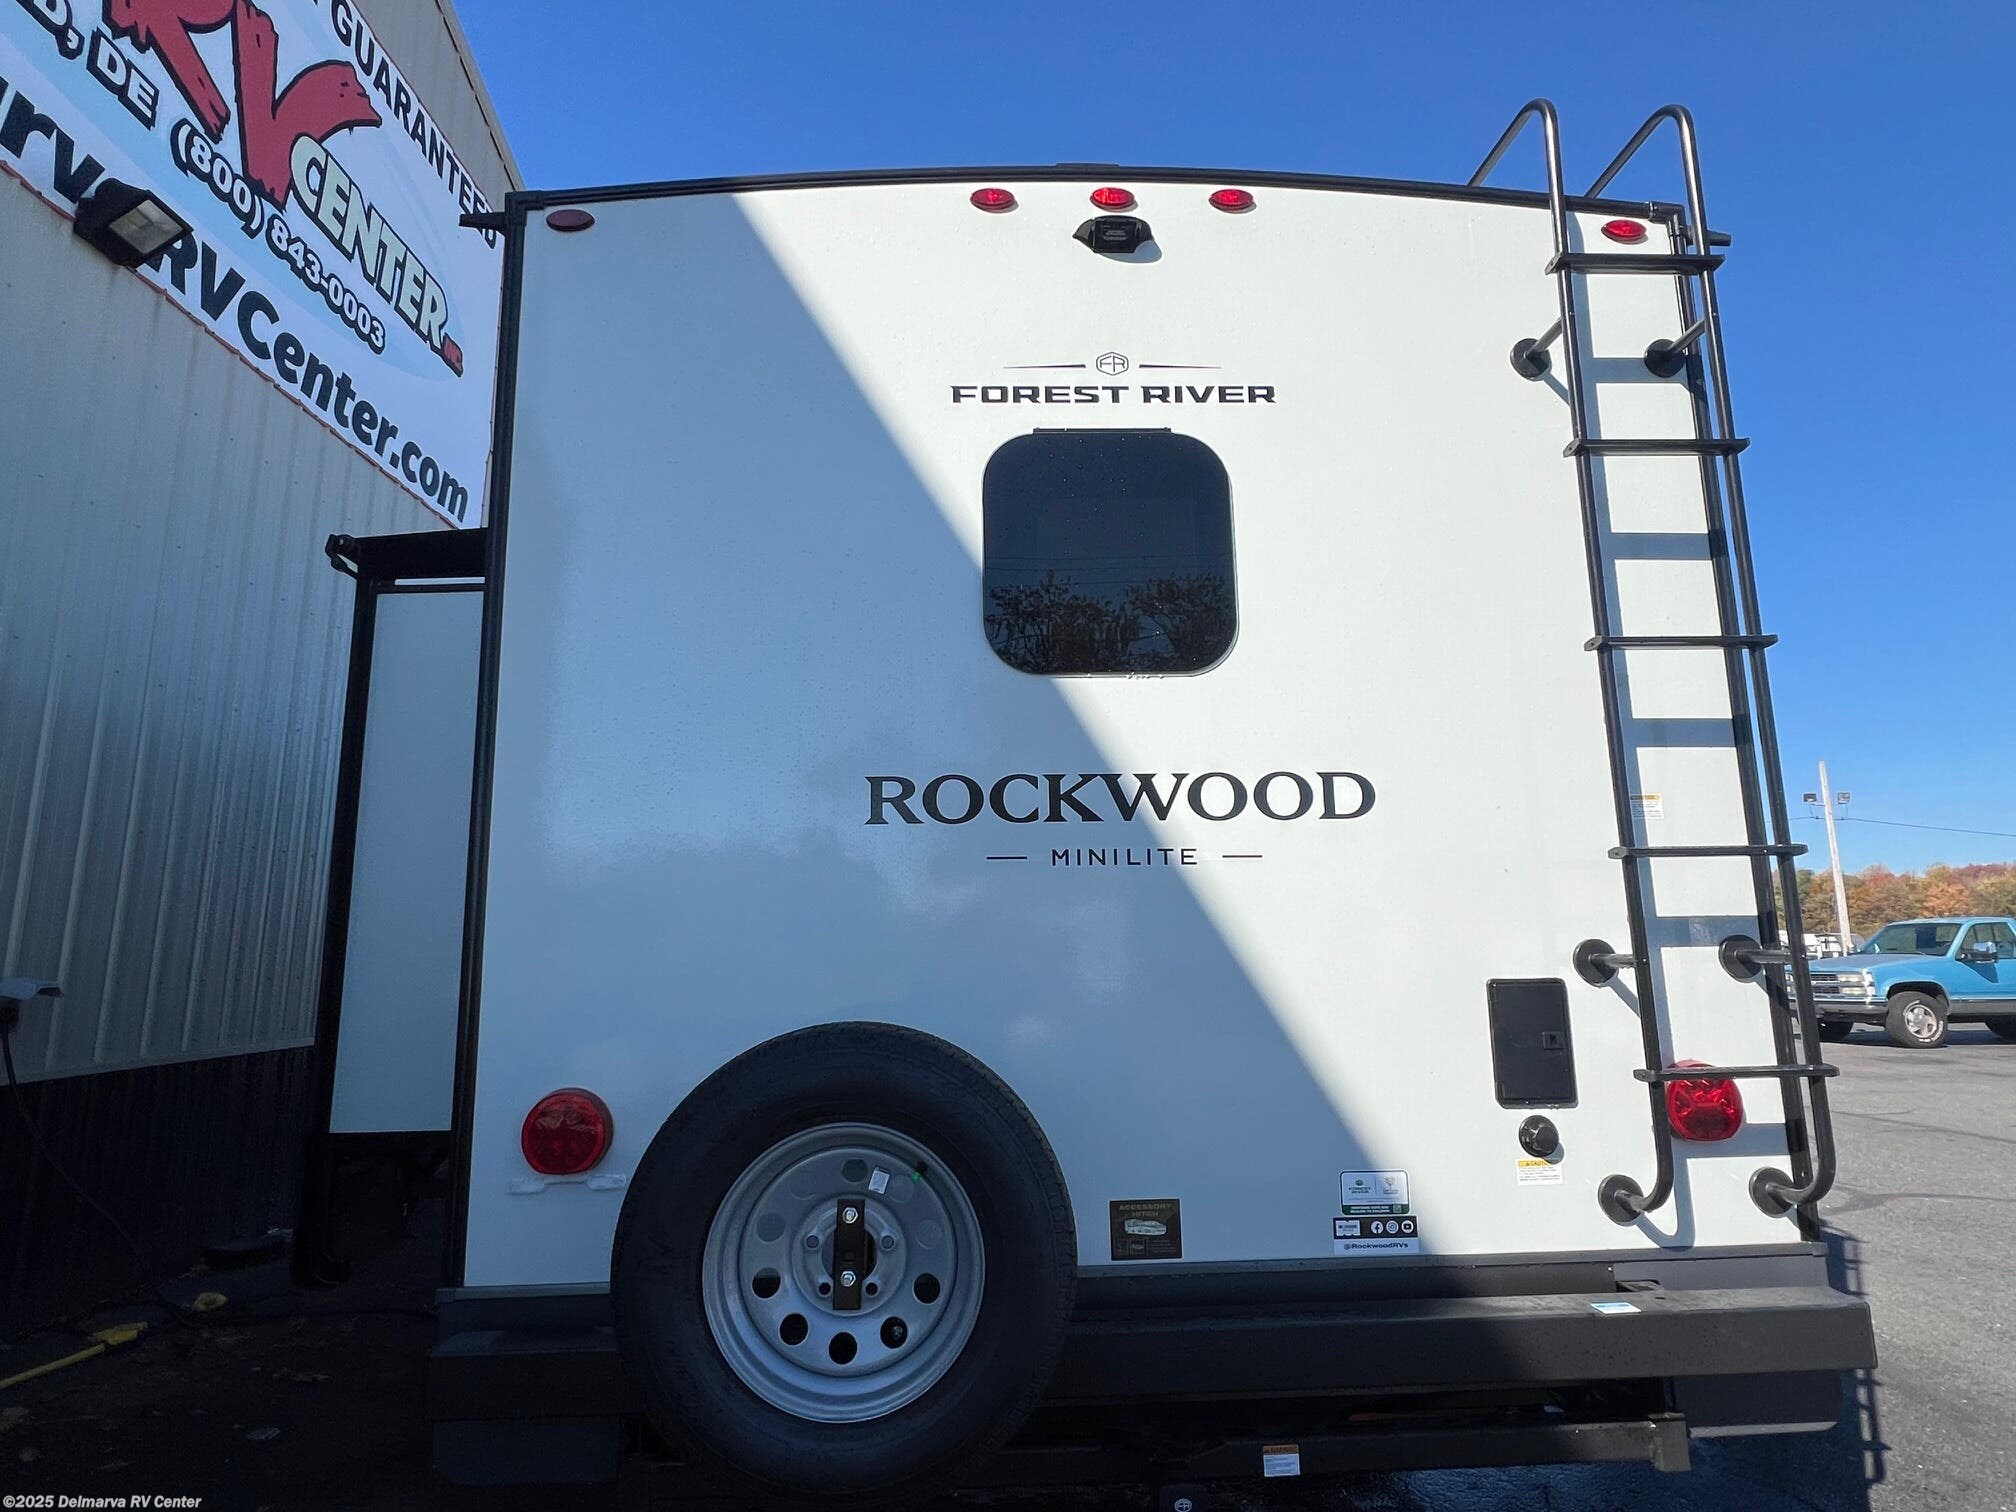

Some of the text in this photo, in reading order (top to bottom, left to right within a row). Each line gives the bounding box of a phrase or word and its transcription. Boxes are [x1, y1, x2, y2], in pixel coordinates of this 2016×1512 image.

[87, 27, 160, 131] DE
[171, 119, 386, 354] (800) 843-0003
[291, 133, 448, 353] CENTER
[0, 76, 469, 523] rvRVCenter.com
[950, 385, 1278, 404] FOREST RIVER
[864, 771, 1376, 826] ROCKWOOD
[1051, 848, 1198, 866] MINILITE
